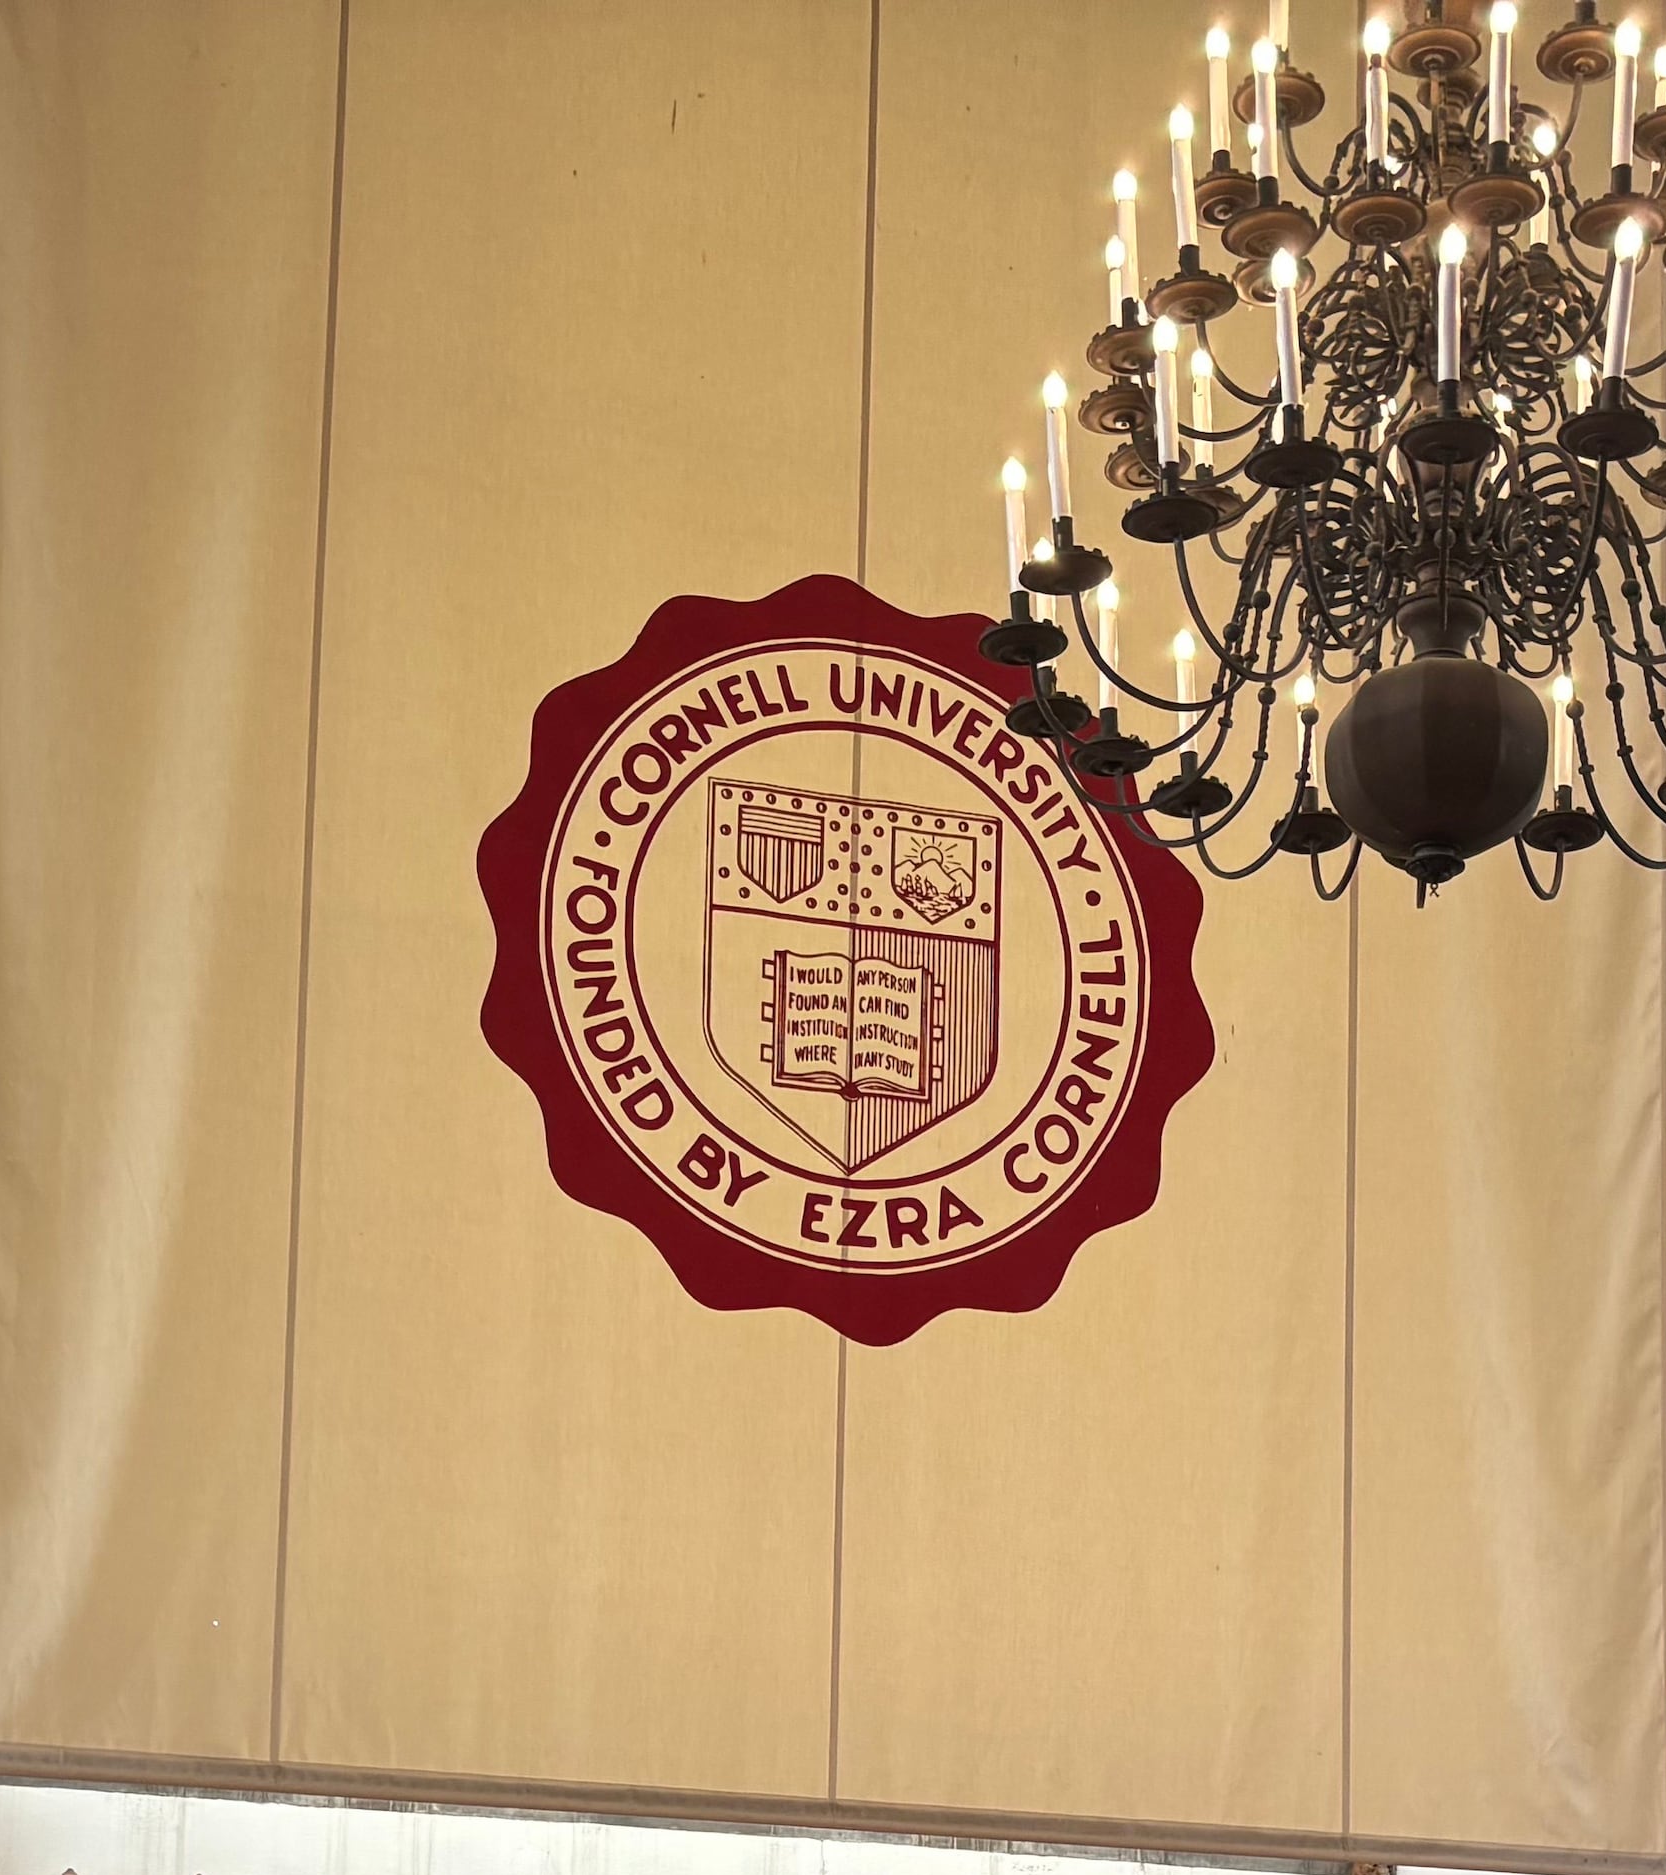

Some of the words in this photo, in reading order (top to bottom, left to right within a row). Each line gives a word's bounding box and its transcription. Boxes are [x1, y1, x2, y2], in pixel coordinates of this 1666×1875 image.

[599, 664, 809, 827] CORNELL
[829, 663, 1102, 873] UNIVERSITY
[796, 967, 843, 984] WOULD
[857, 969, 877, 987] ANY
[878, 971, 916, 994] PERSON
[788, 992, 829, 1011] FOUND
[832, 995, 847, 1014] AN
[859, 995, 882, 1014] CAN
[884, 998, 909, 1020] FIND
[787, 1019, 848, 1040] INSTITUTION
[855, 1025, 918, 1051] INSTRUCTION
[565, 855, 674, 1132] FOUNDED
[677, 1134, 770, 1208] BY
[800, 1185, 984, 1248] EZRA
[1004, 919, 1126, 1194] CORNELL
[794, 1046, 837, 1065] WHERE
[865, 1052, 884, 1069] ANY
[885, 1057, 915, 1079] STUDY
